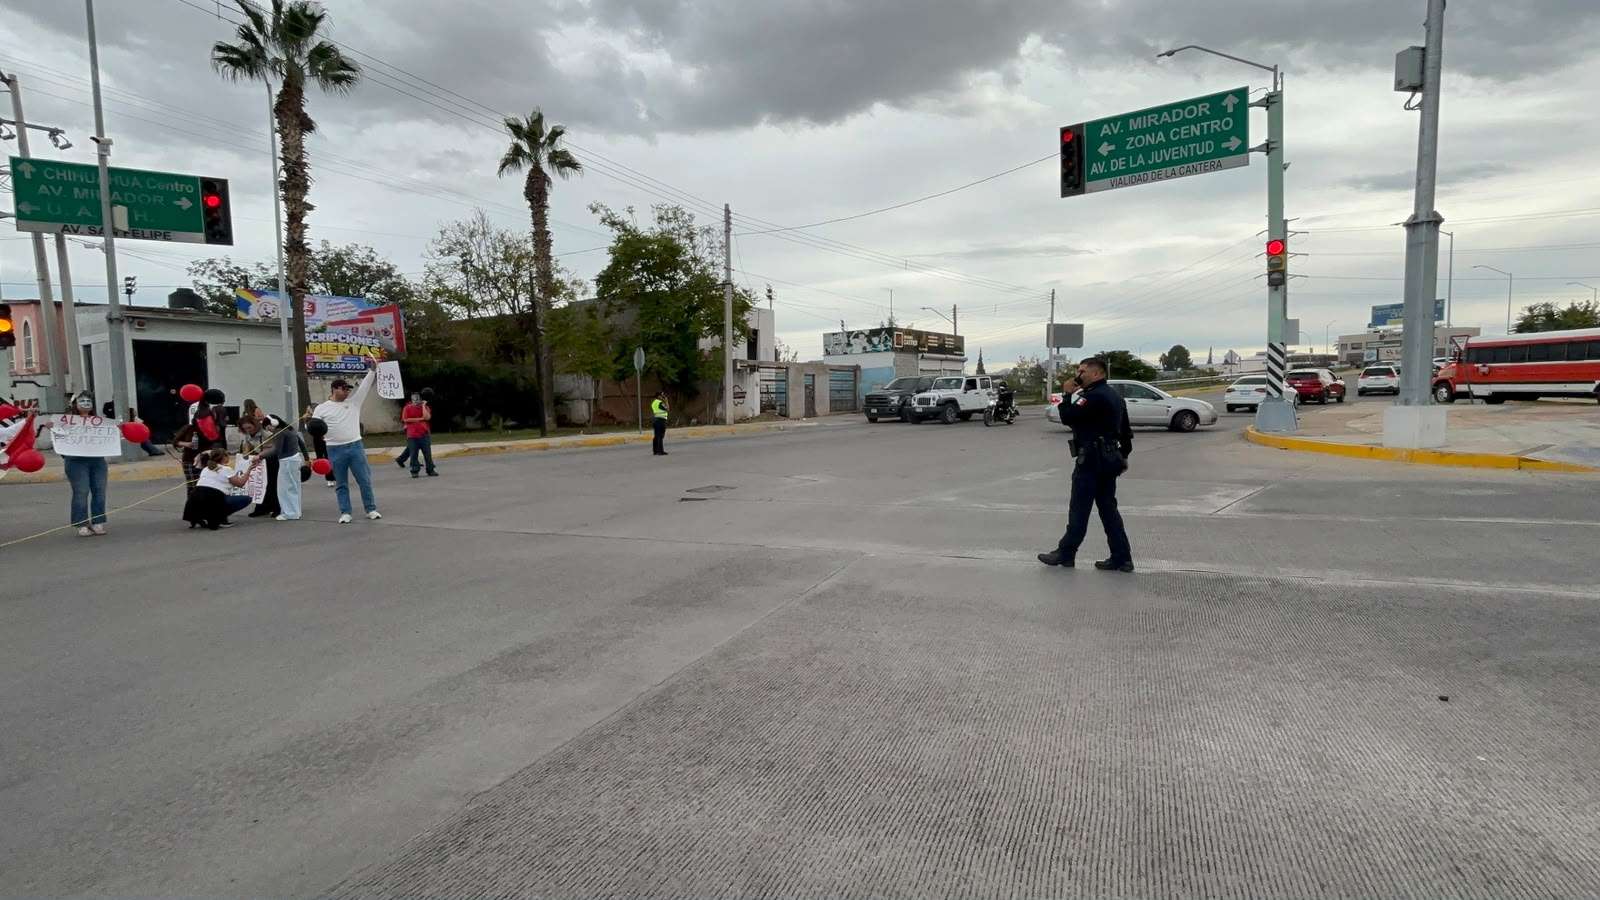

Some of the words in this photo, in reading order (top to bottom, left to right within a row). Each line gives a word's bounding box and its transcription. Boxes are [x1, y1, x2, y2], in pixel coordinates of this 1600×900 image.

[1100, 122, 1124, 137] AV.
[1129, 102, 1211, 131] MIRADOR
[1125, 131, 1166, 150] ZONA
[1170, 117, 1234, 141] CENTRO
[1090, 161, 1108, 175] AV.
[1110, 157, 1126, 172] DE
[1130, 153, 1145, 168] LA
[1148, 140, 1215, 165] JUVENTUD
[43, 167, 143, 189] CHIHUHUA
[146, 177, 194, 193] Centro
[1110, 172, 1149, 188] VIALIDAD
[1151, 170, 1163, 181] DE
[1166, 167, 1177, 179] LA
[1179, 160, 1223, 177] CANTERA
[38, 183, 68, 198] AV.
[60, 224, 83, 235] AV.
[60, 415, 103, 426] ALTO
